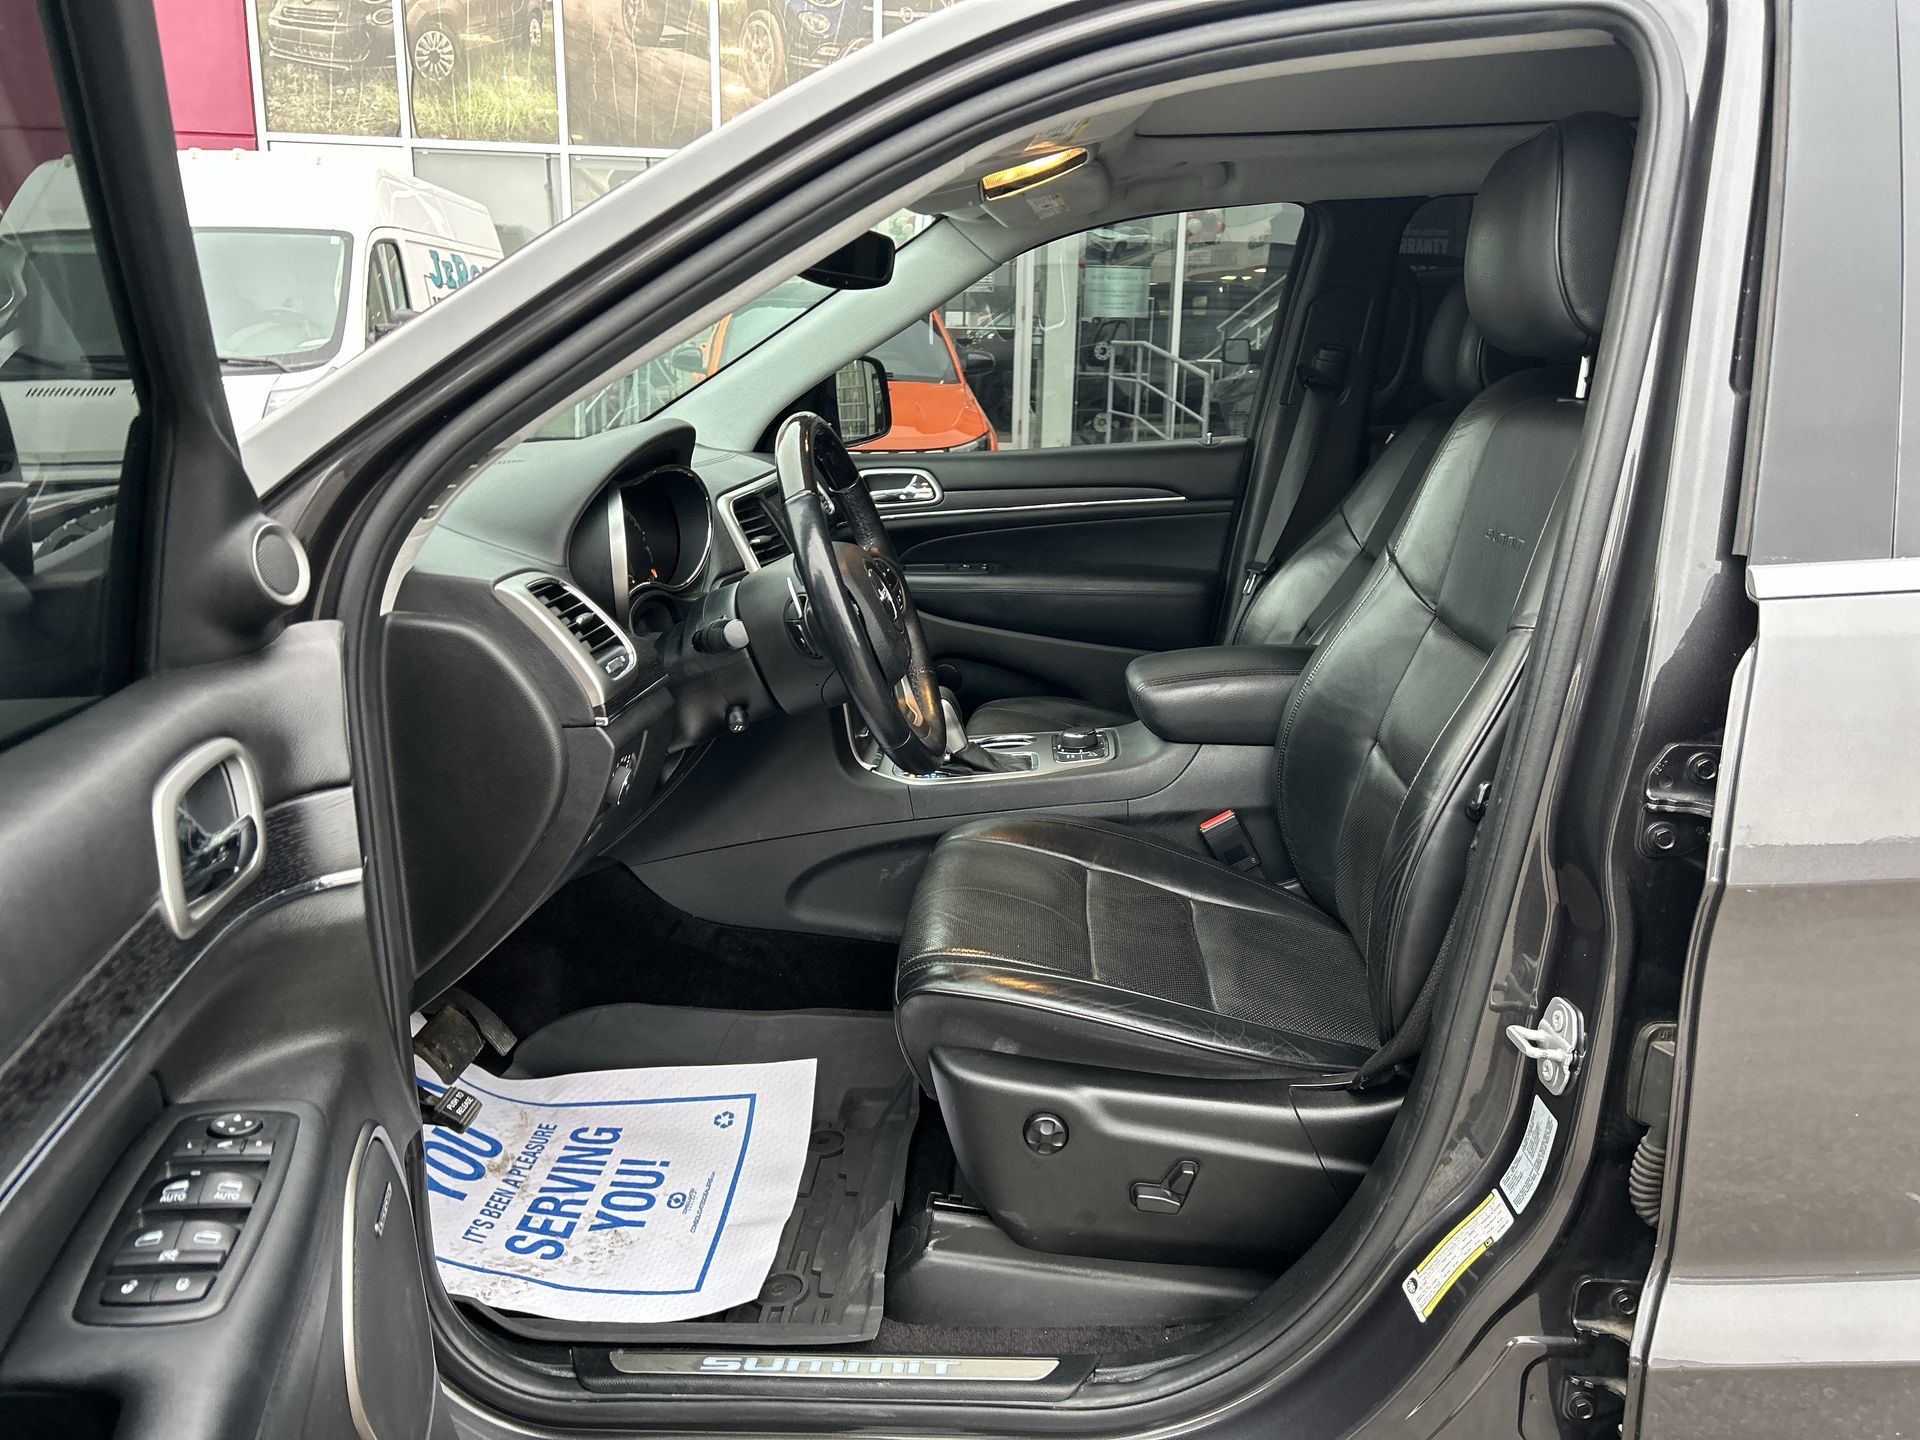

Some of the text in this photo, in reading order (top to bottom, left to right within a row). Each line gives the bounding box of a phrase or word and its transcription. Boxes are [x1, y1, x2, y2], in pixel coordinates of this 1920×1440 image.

[446, 1091, 464, 1111] PUSH TO
[456, 1096, 474, 1115] RELEASE
[462, 1122, 558, 1244] IT'S BEEN A PLEASURE
[160, 1192, 187, 1202] AUTO
[213, 1192, 240, 1201] AUTO
[504, 1126, 624, 1260] SERVING
[588, 1158, 671, 1232] YOU!
[700, 1356, 962, 1375] SUMMIT
